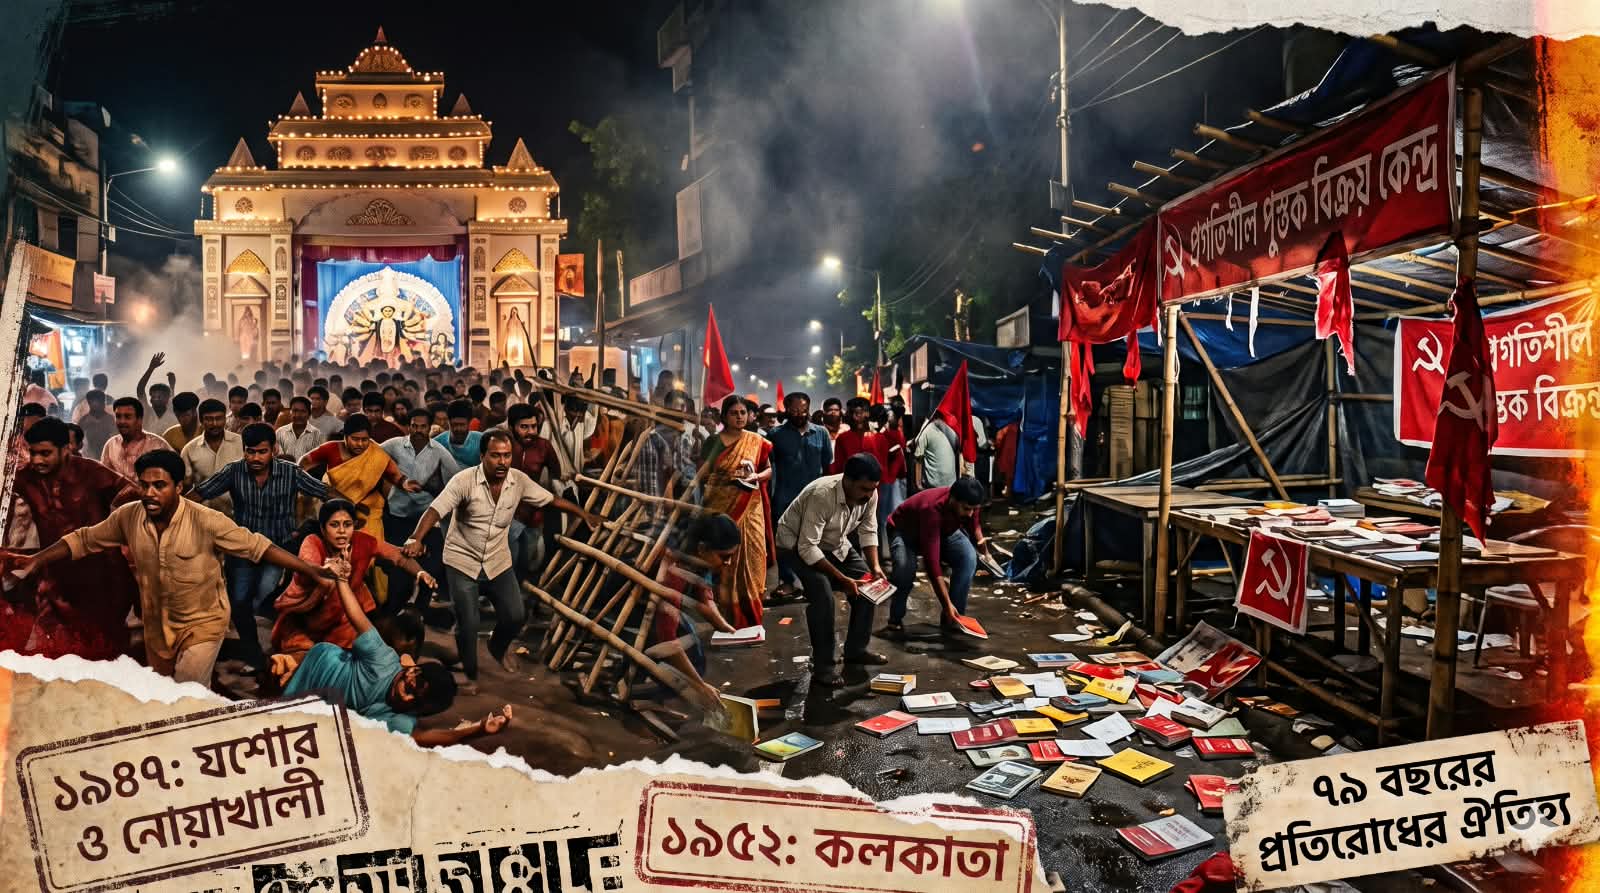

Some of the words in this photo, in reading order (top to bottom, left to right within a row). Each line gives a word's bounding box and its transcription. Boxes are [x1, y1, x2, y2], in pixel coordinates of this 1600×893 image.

[1189, 192, 1257, 267] প্রগতিশীল
[1263, 180, 1309, 258] পুস্তক
[1311, 155, 1372, 224] বিক্রয়
[1379, 124, 1438, 200] কেন্দ্র
